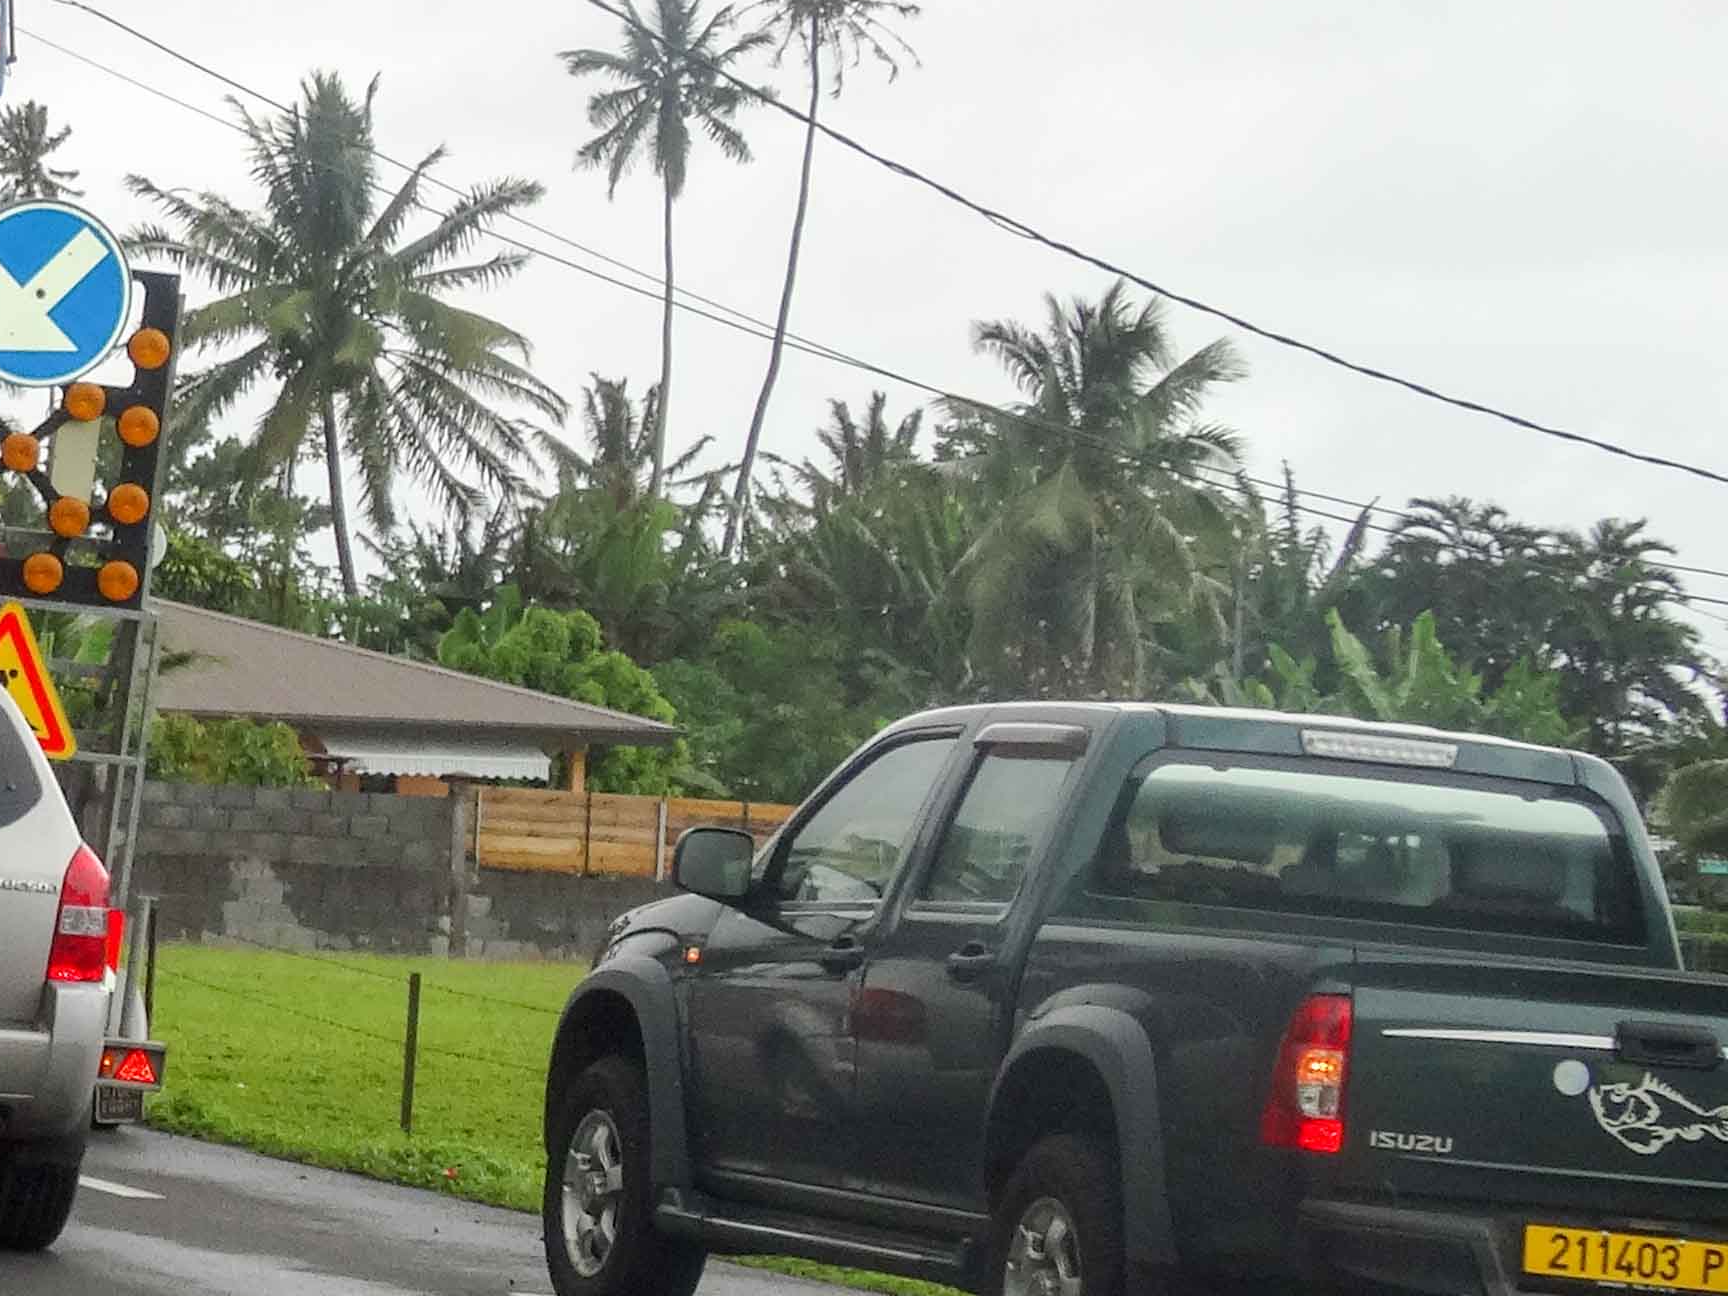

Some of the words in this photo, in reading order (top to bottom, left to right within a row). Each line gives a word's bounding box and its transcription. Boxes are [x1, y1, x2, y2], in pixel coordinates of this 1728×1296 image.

[1370, 1131, 1453, 1153] ISUZU
[1548, 1233, 1681, 1281] 211403
[1702, 1248, 1725, 1285] P
